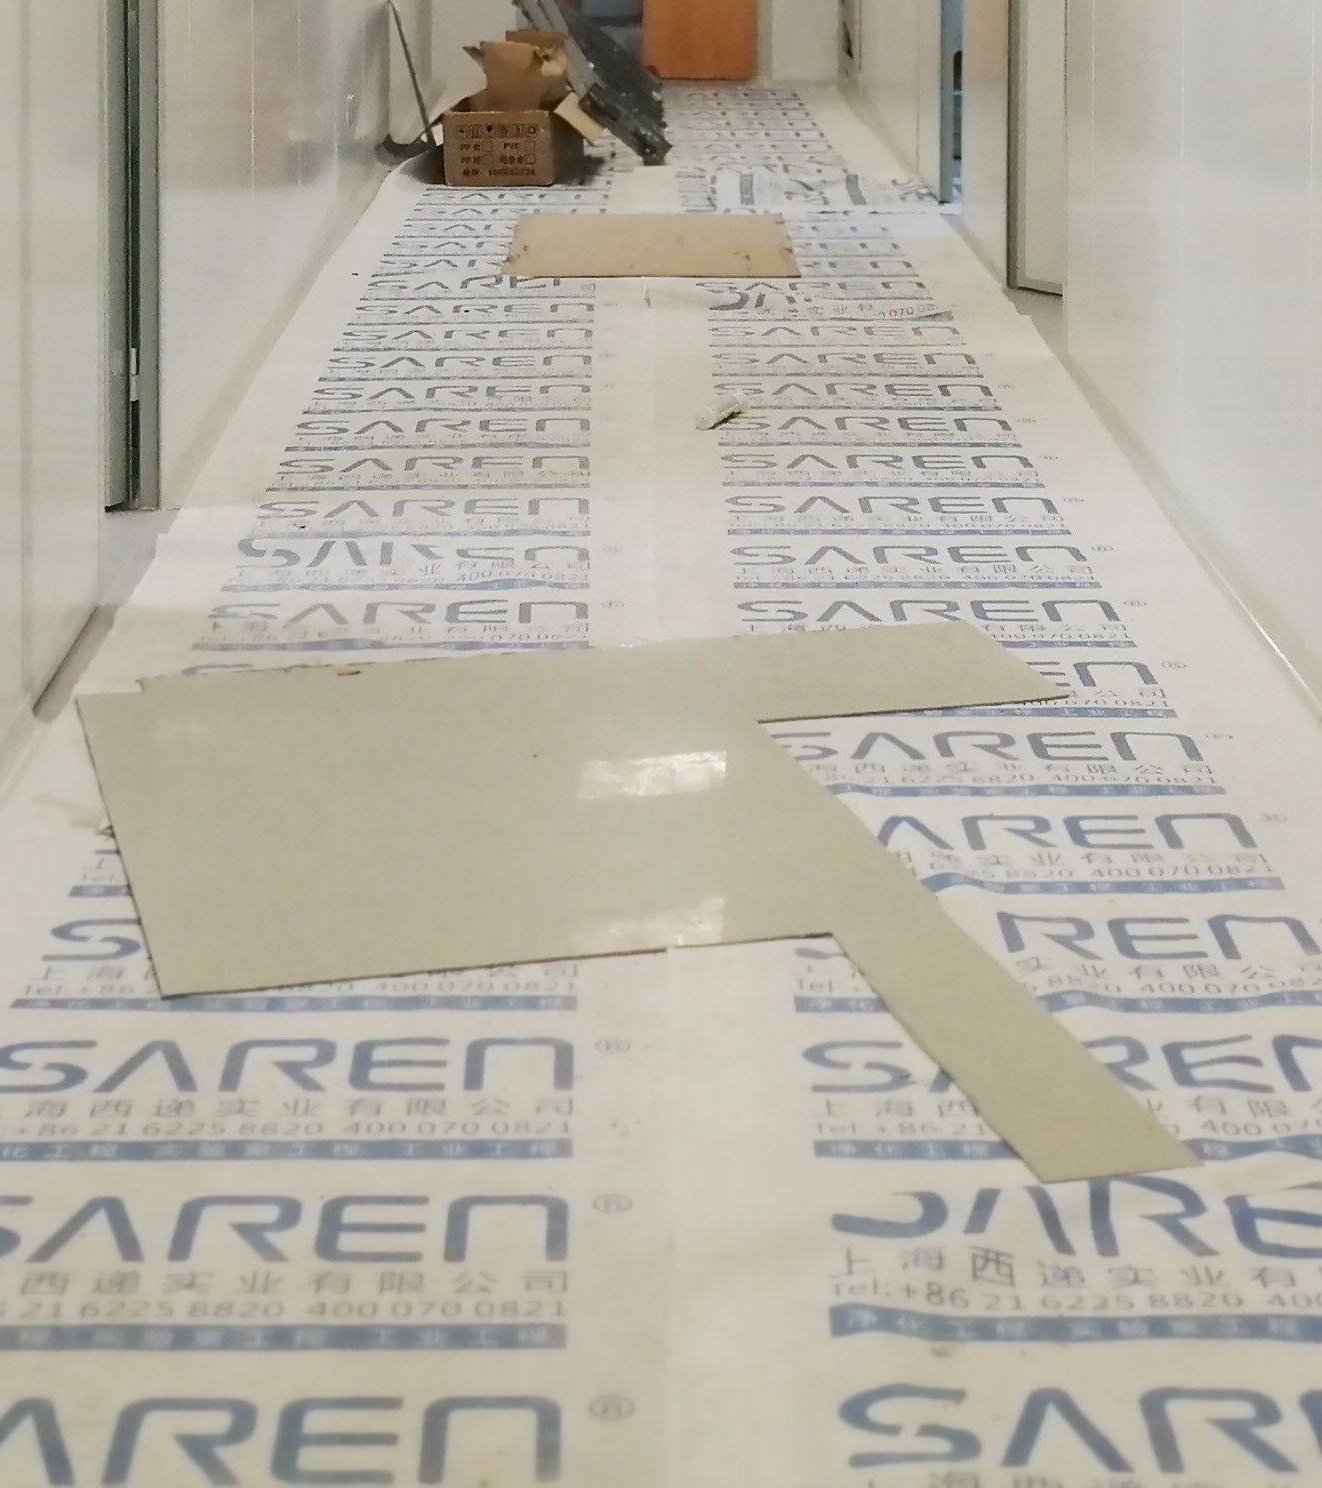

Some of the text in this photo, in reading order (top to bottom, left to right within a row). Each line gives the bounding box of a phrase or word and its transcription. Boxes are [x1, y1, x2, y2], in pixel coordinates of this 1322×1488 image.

[355, 302, 594, 315] SAREN
[342, 327, 593, 341] SAREN
[709, 326, 960, 337] SAREN
[327, 354, 591, 369] SAREN
[711, 352, 977, 365] SAREN
[312, 384, 590, 401] SAREN
[713, 382, 993, 397] SAREN
[294, 418, 590, 436] SAREN
[718, 416, 1013, 431] SAREN
[277, 455, 590, 475] SAREN
[720, 454, 1034, 470] SAREN
[257, 497, 589, 519] SAREN
[725, 495, 1058, 515] SAREN
[730, 545, 1088, 565] SAREN
[737, 599, 1120, 623] SAREN
[877, 813, 1259, 851] AREN
[1090, 865, 1142, 879] 400
[1148, 865, 1202, 878] 070
[997, 911, 1322, 961] REN
[1139, 983, 1196, 994] 400
[1203, 982, 1260, 994] 070
[142, 1122, 226, 1136] 6225
[238, 1122, 323, 1136] 8820
[344, 1121, 407, 1135] 400
[417, 1121, 480, 1135] 070
[491, 1121, 570, 1135] 0821
[1200, 1119, 1263, 1135] 400
[984, 1294, 1028, 1310] 21
[1040, 1293, 1136, 1310] 6225
[1148, 1292, 1244, 1310] 8820
[79, 1301, 175, 1319] 6225
[186, 1301, 285, 1318] 8820
[305, 1301, 379, 1318] 400
[390, 1301, 462, 1318] 070
[474, 1301, 569, 1318] 0821
